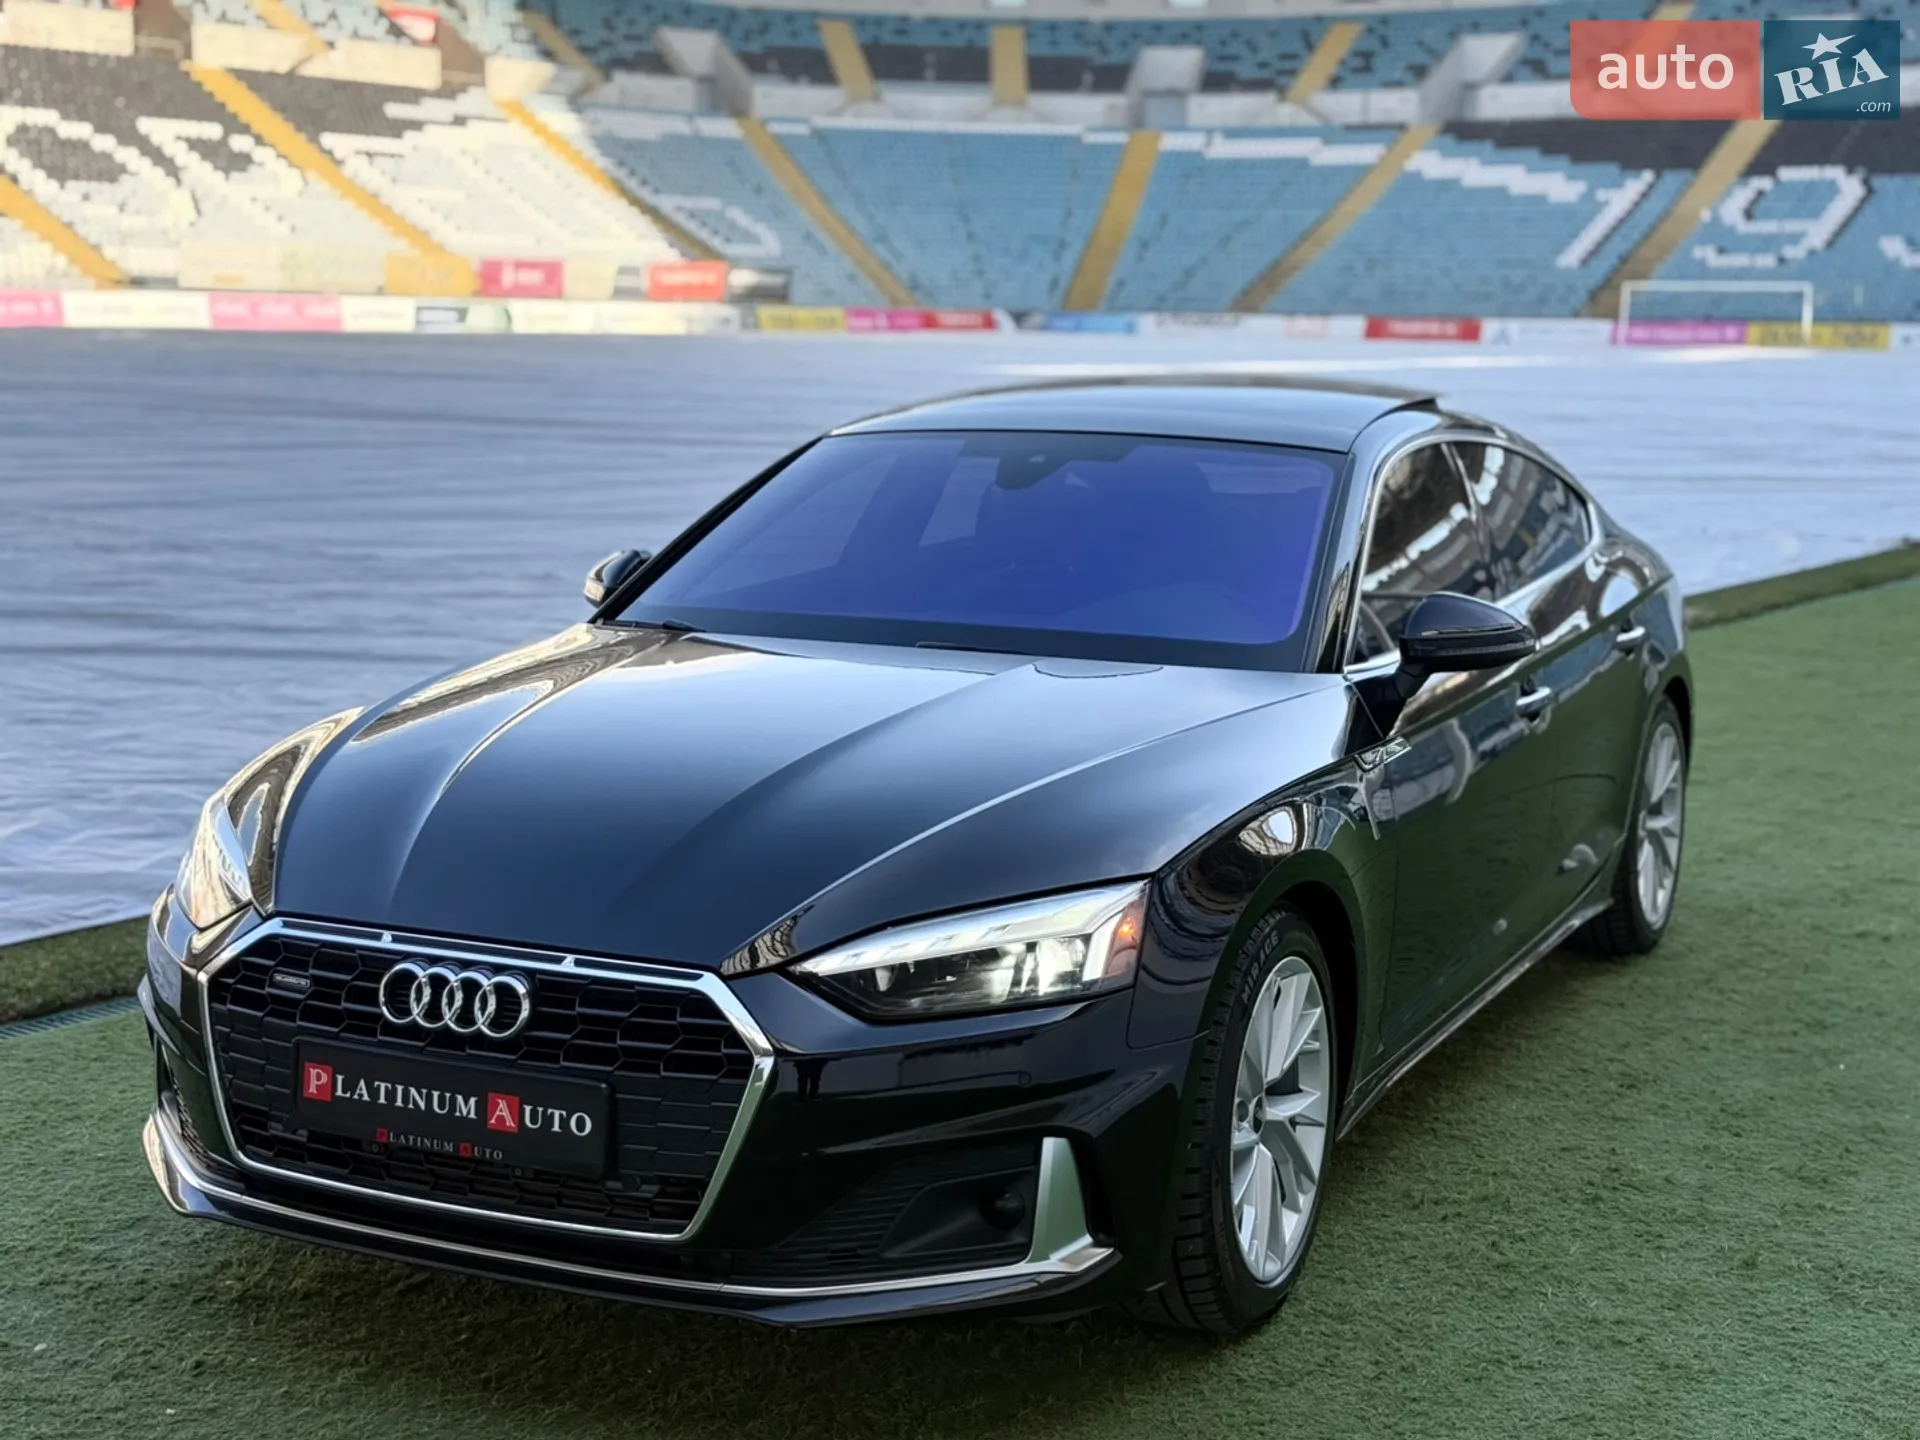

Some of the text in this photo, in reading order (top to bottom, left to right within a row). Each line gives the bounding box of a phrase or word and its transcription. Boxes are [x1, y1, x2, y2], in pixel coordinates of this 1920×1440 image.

[1241, 929, 1280, 1005] MIRAGE
[306, 1064, 593, 1137] PLATINUM AUTO
